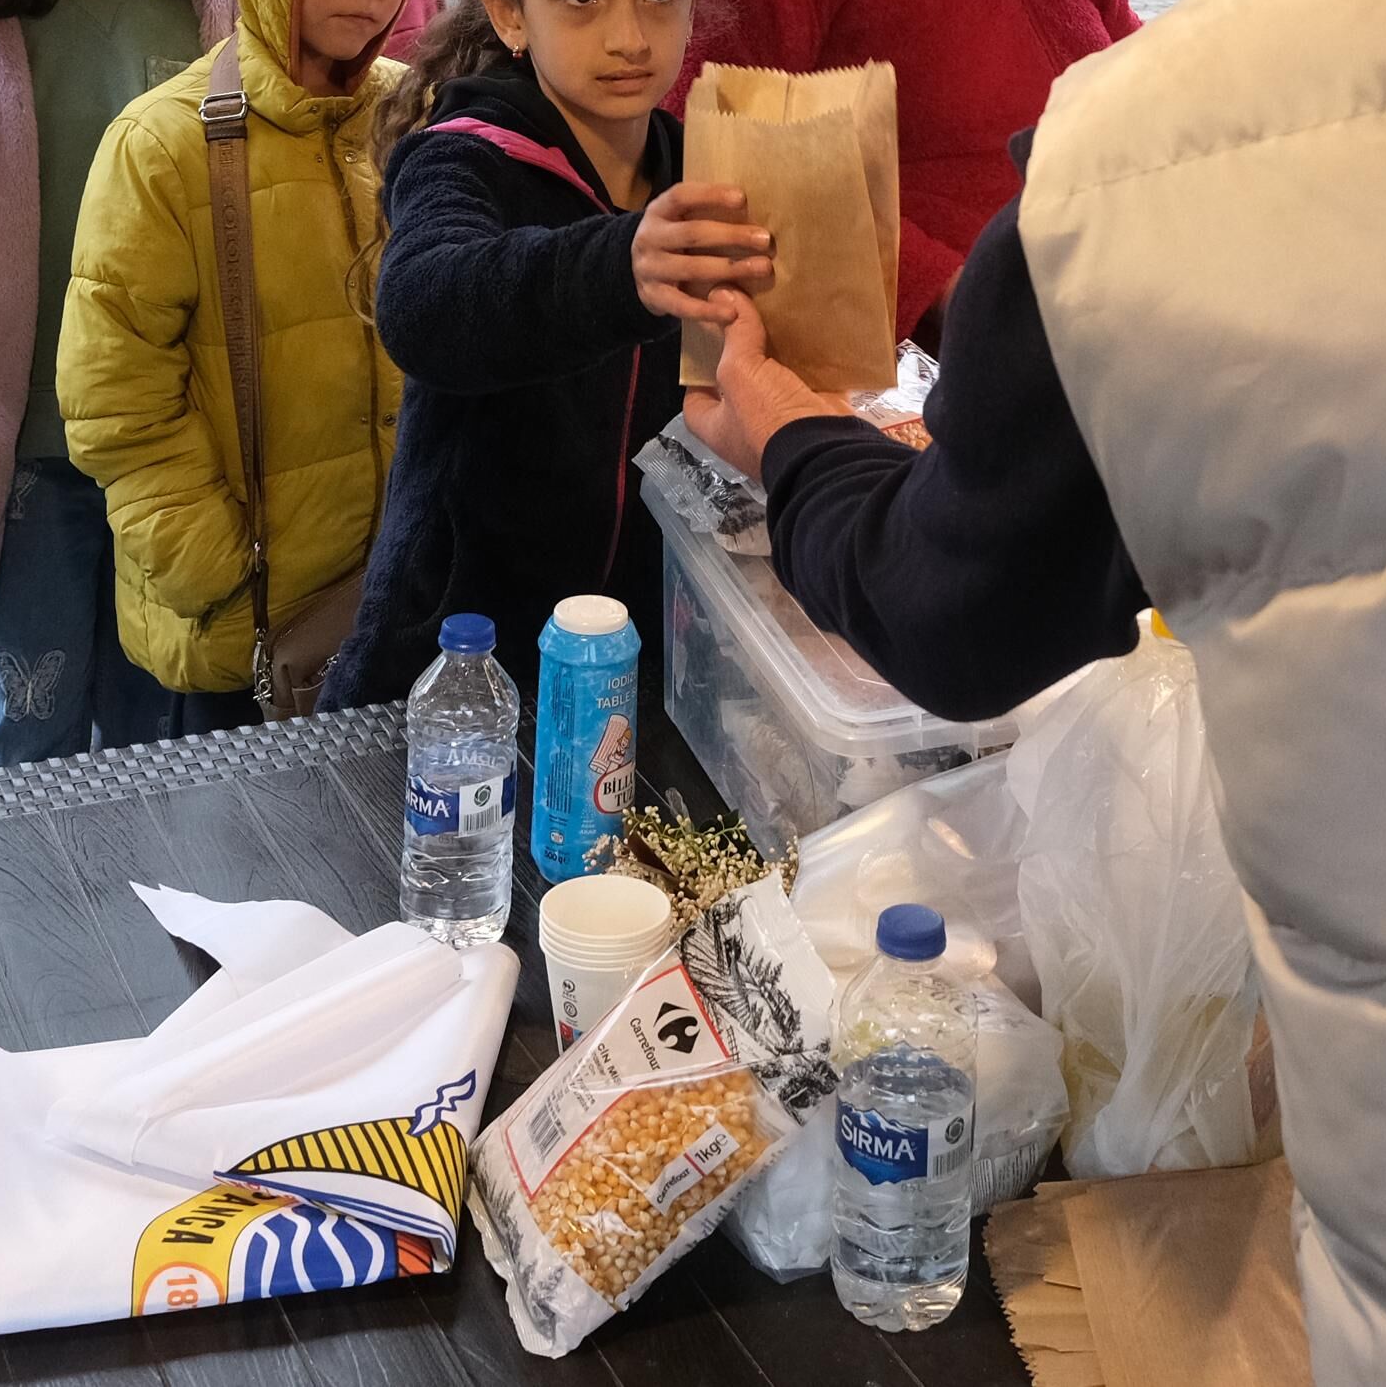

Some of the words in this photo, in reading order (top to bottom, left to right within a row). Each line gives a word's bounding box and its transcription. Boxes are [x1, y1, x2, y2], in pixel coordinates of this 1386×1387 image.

[596, 695, 630, 710] TABLE
[630, 1017, 661, 1071] Carrefour
[841, 1115, 916, 1161] SIRMA
[656, 1167, 691, 1204] Carrefour
[162, 1191, 277, 1245] ANCA
[167, 1274, 199, 1309] 18
